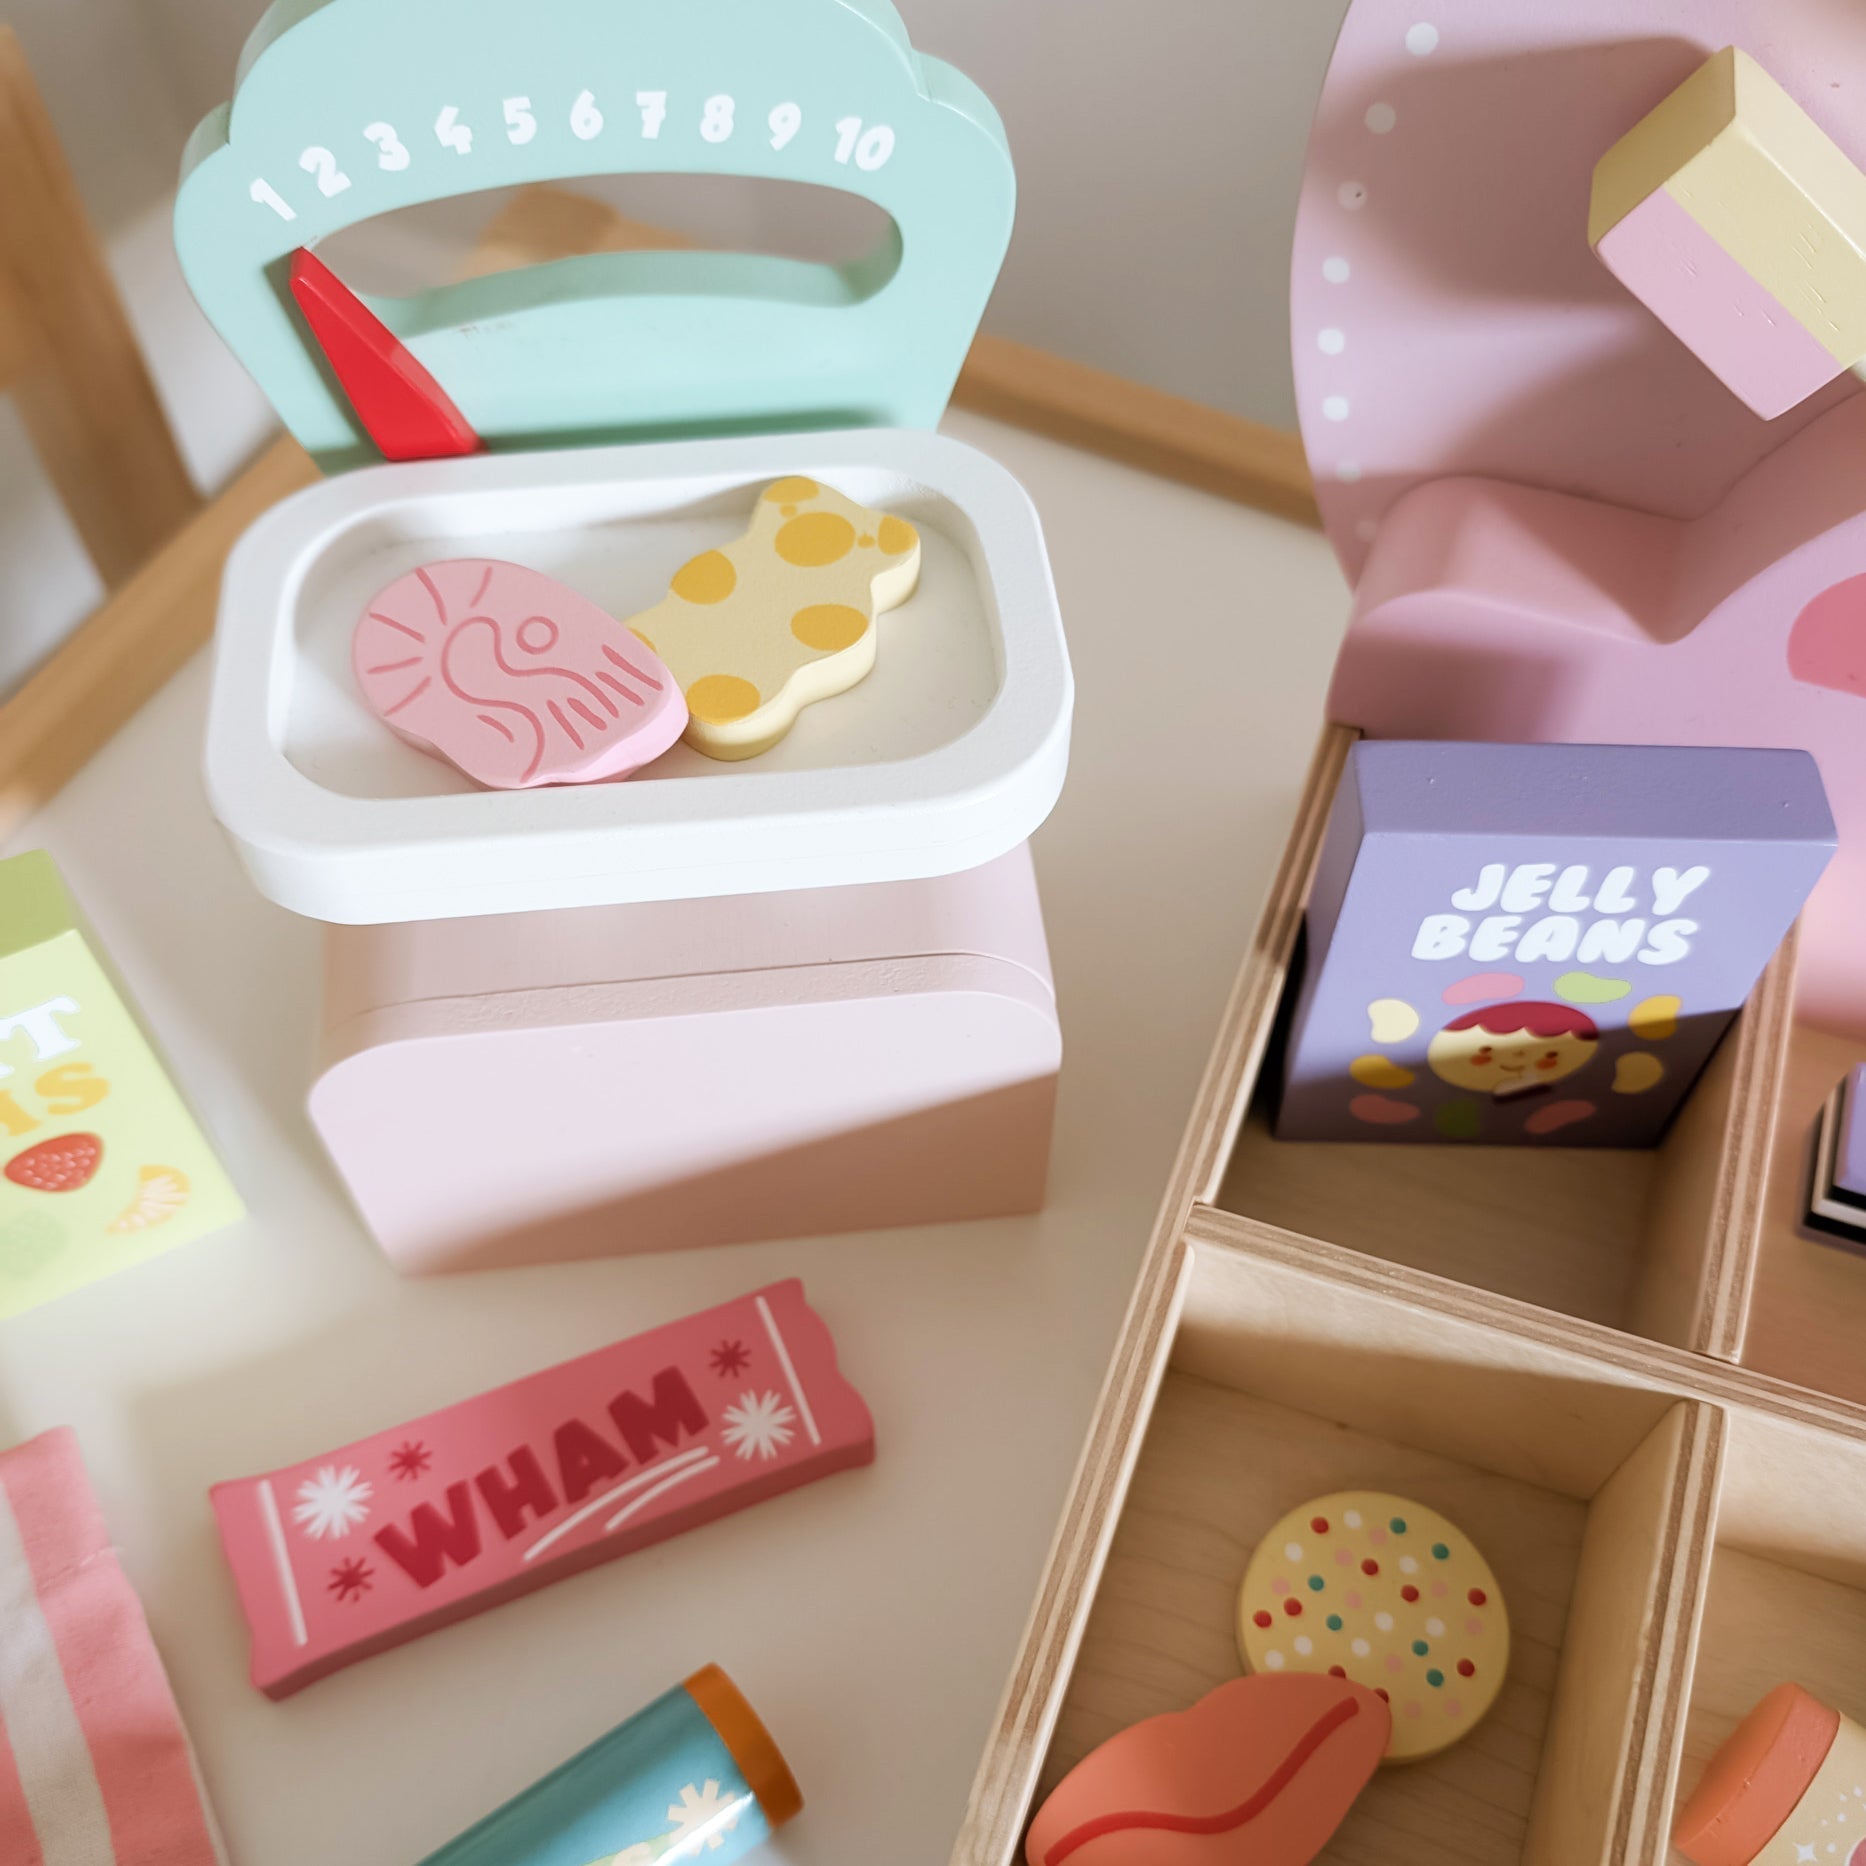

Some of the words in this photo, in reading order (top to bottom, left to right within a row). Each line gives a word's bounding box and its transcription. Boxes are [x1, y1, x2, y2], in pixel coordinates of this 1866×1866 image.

[249, 177, 297, 222] 1
[298, 146, 352, 198] 2
[363, 121, 411, 172] 3
[434, 105, 473, 155] 4
[502, 96, 537, 145] 5
[569, 89, 604, 141] 6
[635, 90, 668, 139] 7
[699, 93, 736, 143] 8
[767, 101, 802, 151] 9
[834, 116, 896, 171] 10
[1450, 862, 1711, 916] JELLY
[1410, 912, 1700, 966] BEANS
[373, 1365, 710, 1589] WHAM
